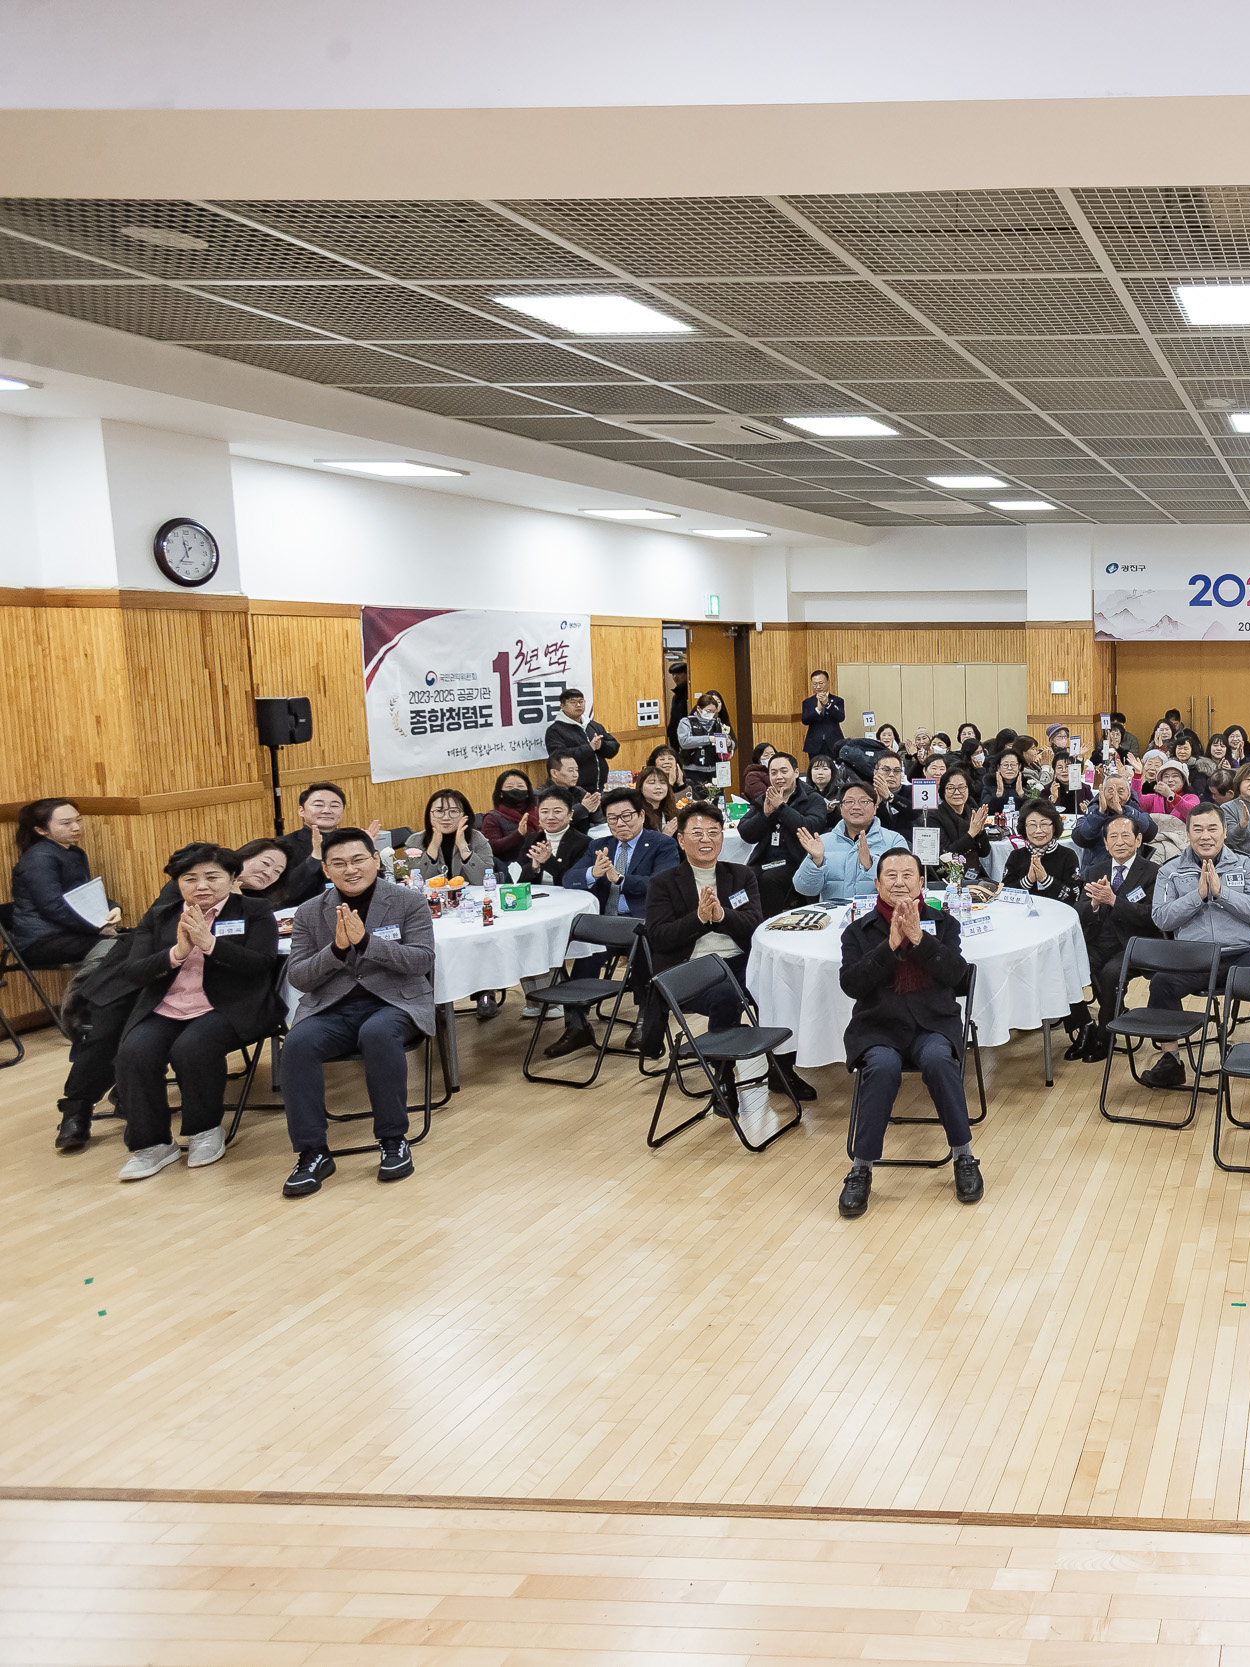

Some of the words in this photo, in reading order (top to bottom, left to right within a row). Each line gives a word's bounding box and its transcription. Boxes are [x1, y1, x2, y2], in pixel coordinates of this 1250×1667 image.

[1121, 564, 1147, 573] 광진구
[512, 639, 541, 677] 3년
[544, 640, 571, 675] 연속
[408, 688, 455, 704] 2023-2025
[456, 687, 492, 702] 공공기관
[409, 704, 494, 736] 종합청렴도
[446, 745, 469, 759] 여러분
[921, 790, 929, 801] 3
